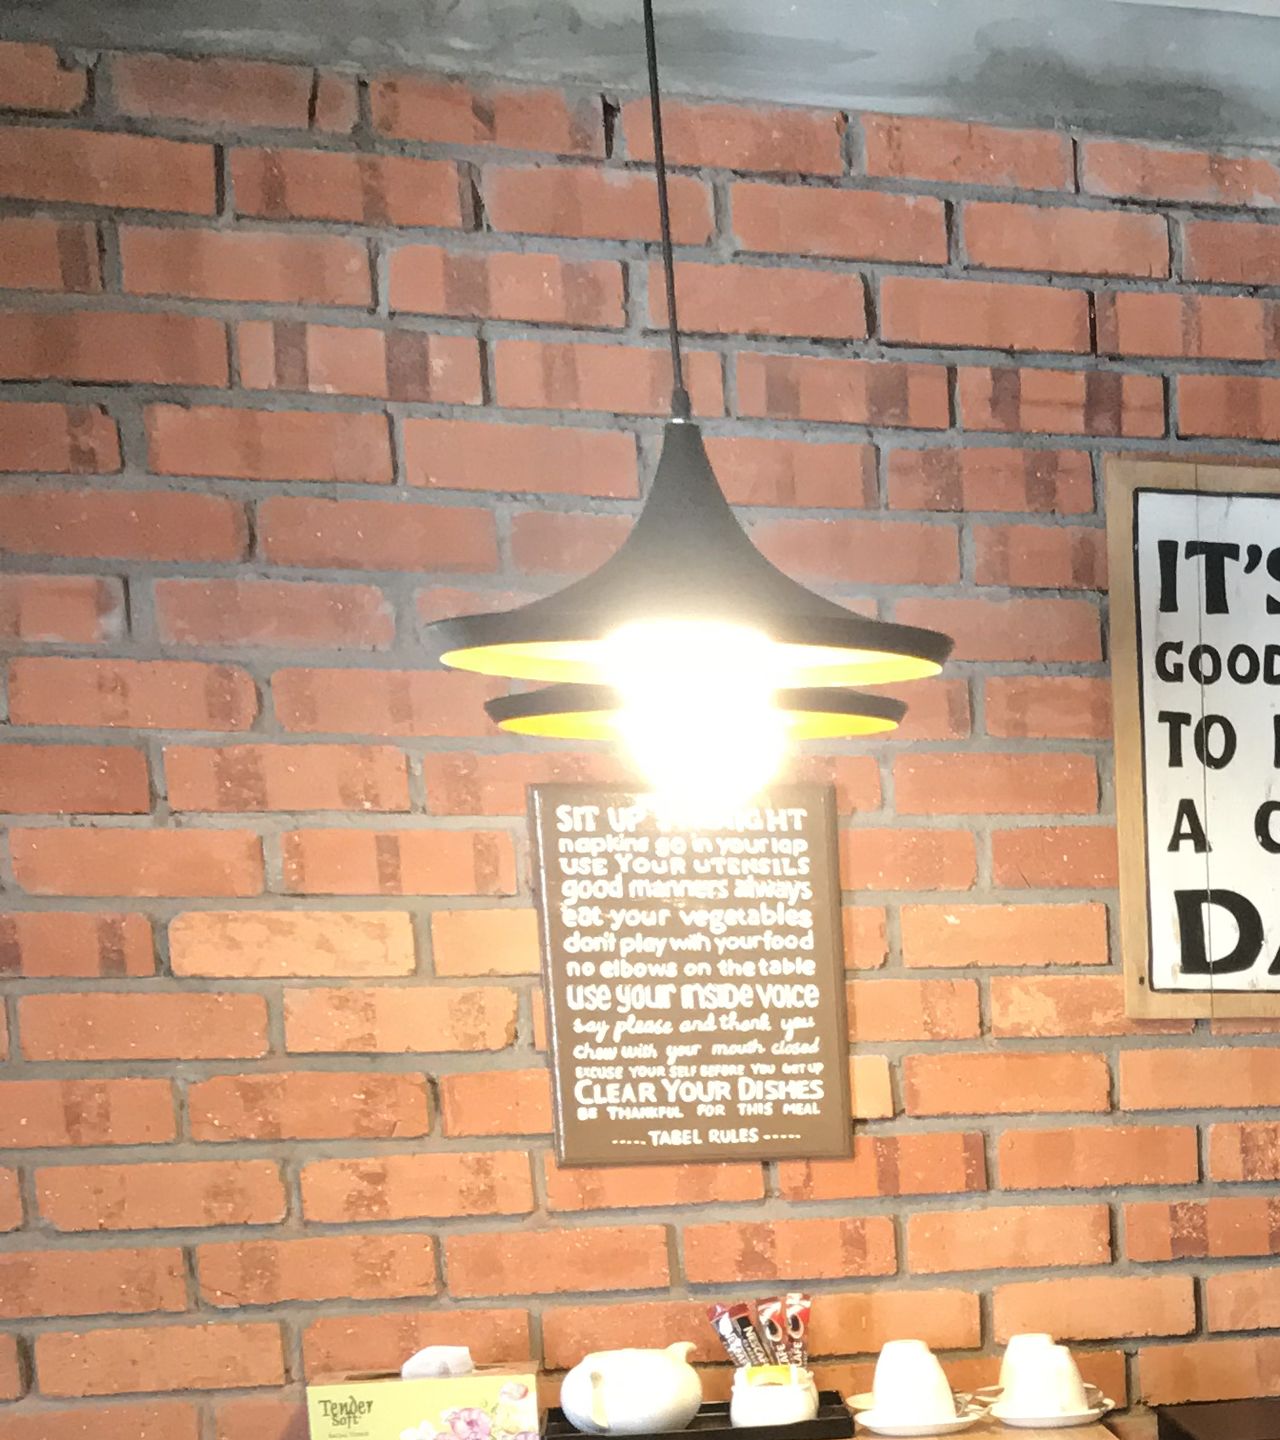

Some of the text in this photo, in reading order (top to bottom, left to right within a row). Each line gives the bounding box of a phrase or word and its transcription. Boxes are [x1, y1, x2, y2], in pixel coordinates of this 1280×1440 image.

[1158, 711, 1236, 769] TO
[556, 804, 600, 832] SIT
[607, 805, 647, 832] UP
[1168, 799, 1212, 853] A
[654, 836, 688, 857] go
[691, 832, 713, 852] in
[715, 836, 769, 857] your
[771, 836, 809, 857] lap
[559, 857, 608, 876] USE
[561, 873, 813, 906] good manners always
[561, 902, 814, 934] eat your vegetables
[620, 931, 668, 957] play
[669, 931, 711, 953] with
[714, 935, 763, 955] your
[762, 929, 814, 951] food
[566, 956, 816, 978] no elbows on the table
[572, 1011, 815, 1042] say please and thank you
[572, 1036, 820, 1065] chew with your mouth closed
[575, 1066, 623, 1079] EXCUSE
[628, 1065, 666, 1078] YOUR
[668, 1065, 697, 1078] SELF
[700, 1065, 745, 1077] BEFORE
[750, 1063, 776, 1075] YOU
[807, 1062, 824, 1075] UP
[574, 1077, 824, 1104] CLEAR YOUR DISHES
[577, 1102, 820, 1121] BE THANKFUL FOR THIS MEAL
[648, 1128, 759, 1146] TABEL RULES
[318, 1395, 373, 1417] Tender
[332, 1415, 359, 1429] Soft
